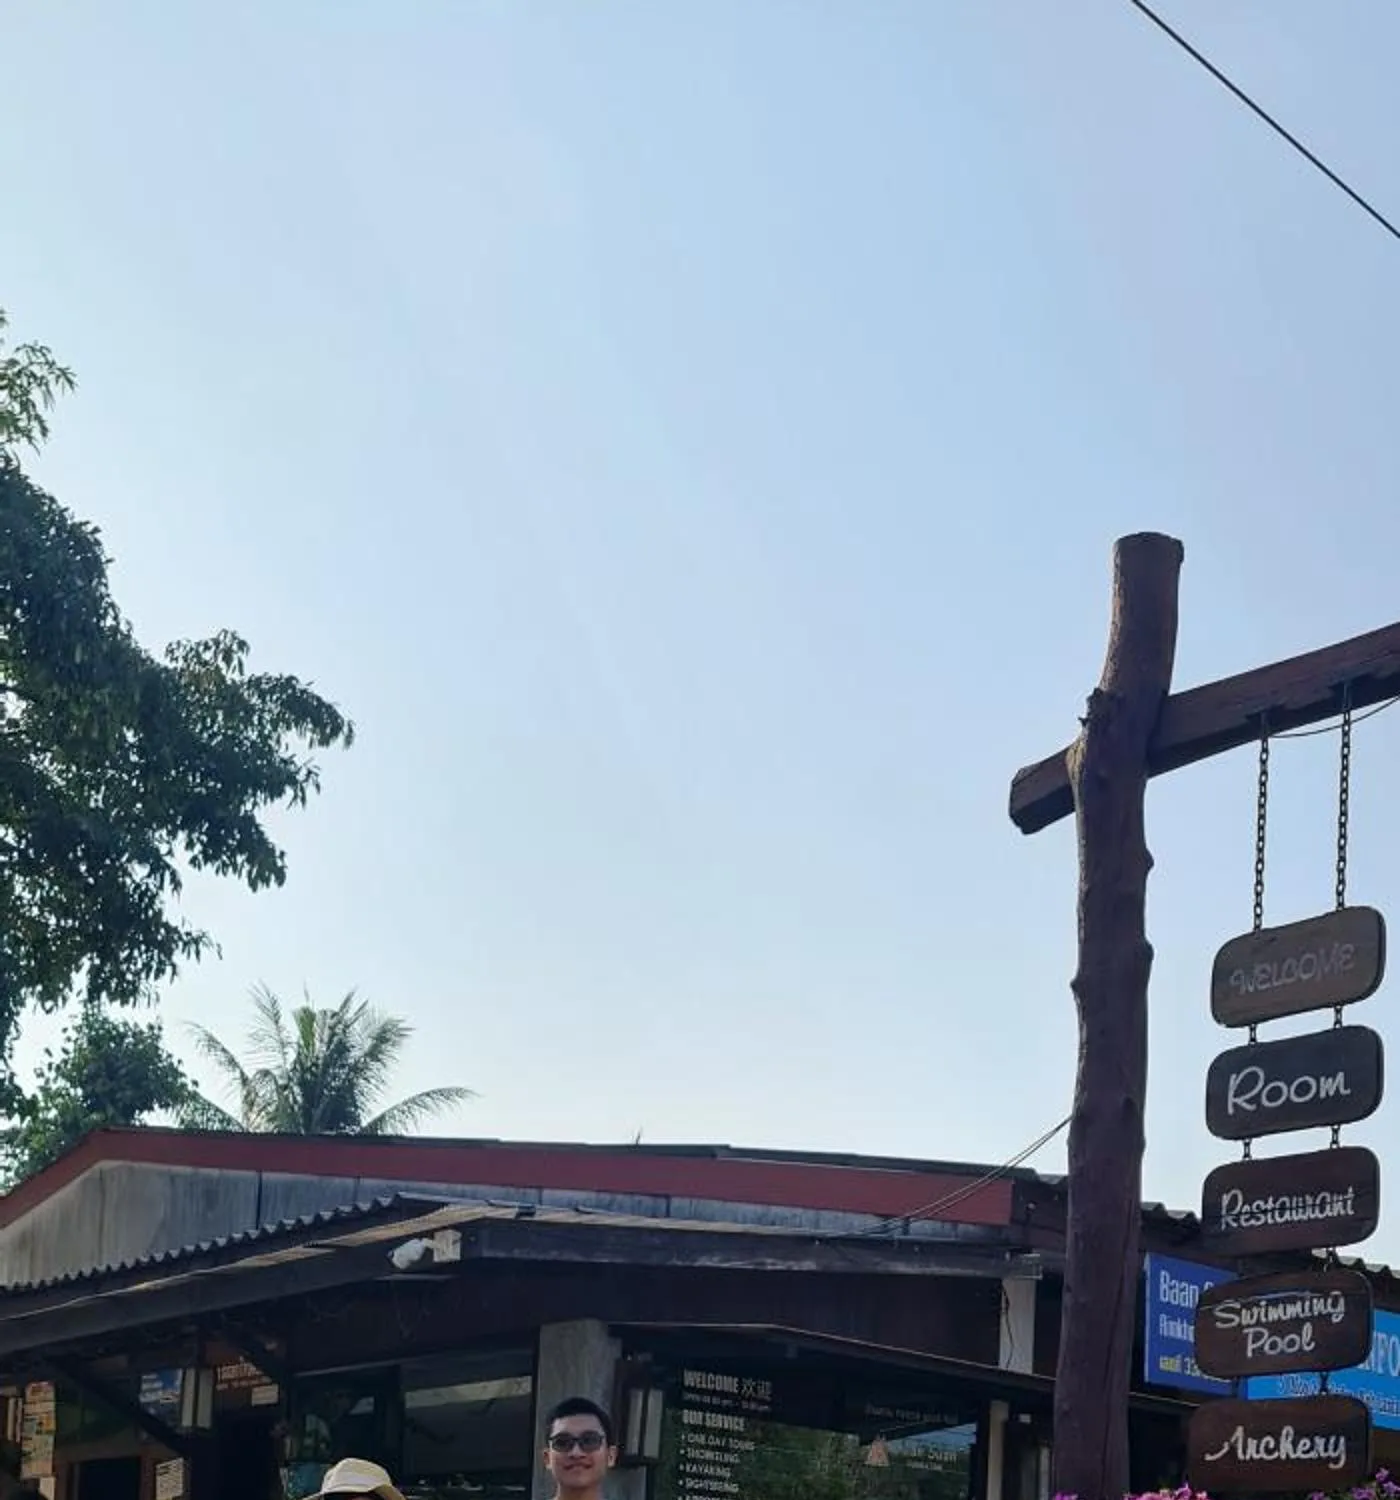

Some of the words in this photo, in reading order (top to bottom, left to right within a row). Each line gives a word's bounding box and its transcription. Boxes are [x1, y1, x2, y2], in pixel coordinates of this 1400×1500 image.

[1230, 943, 1355, 995] WELCOME
[1227, 1066, 1351, 1116] Room
[1221, 1186, 1355, 1232] Restaurant
[1159, 1270, 1199, 1309] Baan
[1213, 1291, 1345, 1329] Swimming
[1242, 1322, 1315, 1357] Pool
[683, 1369, 739, 1393] WELCOME
[1204, 1425, 1346, 1469] Archery
